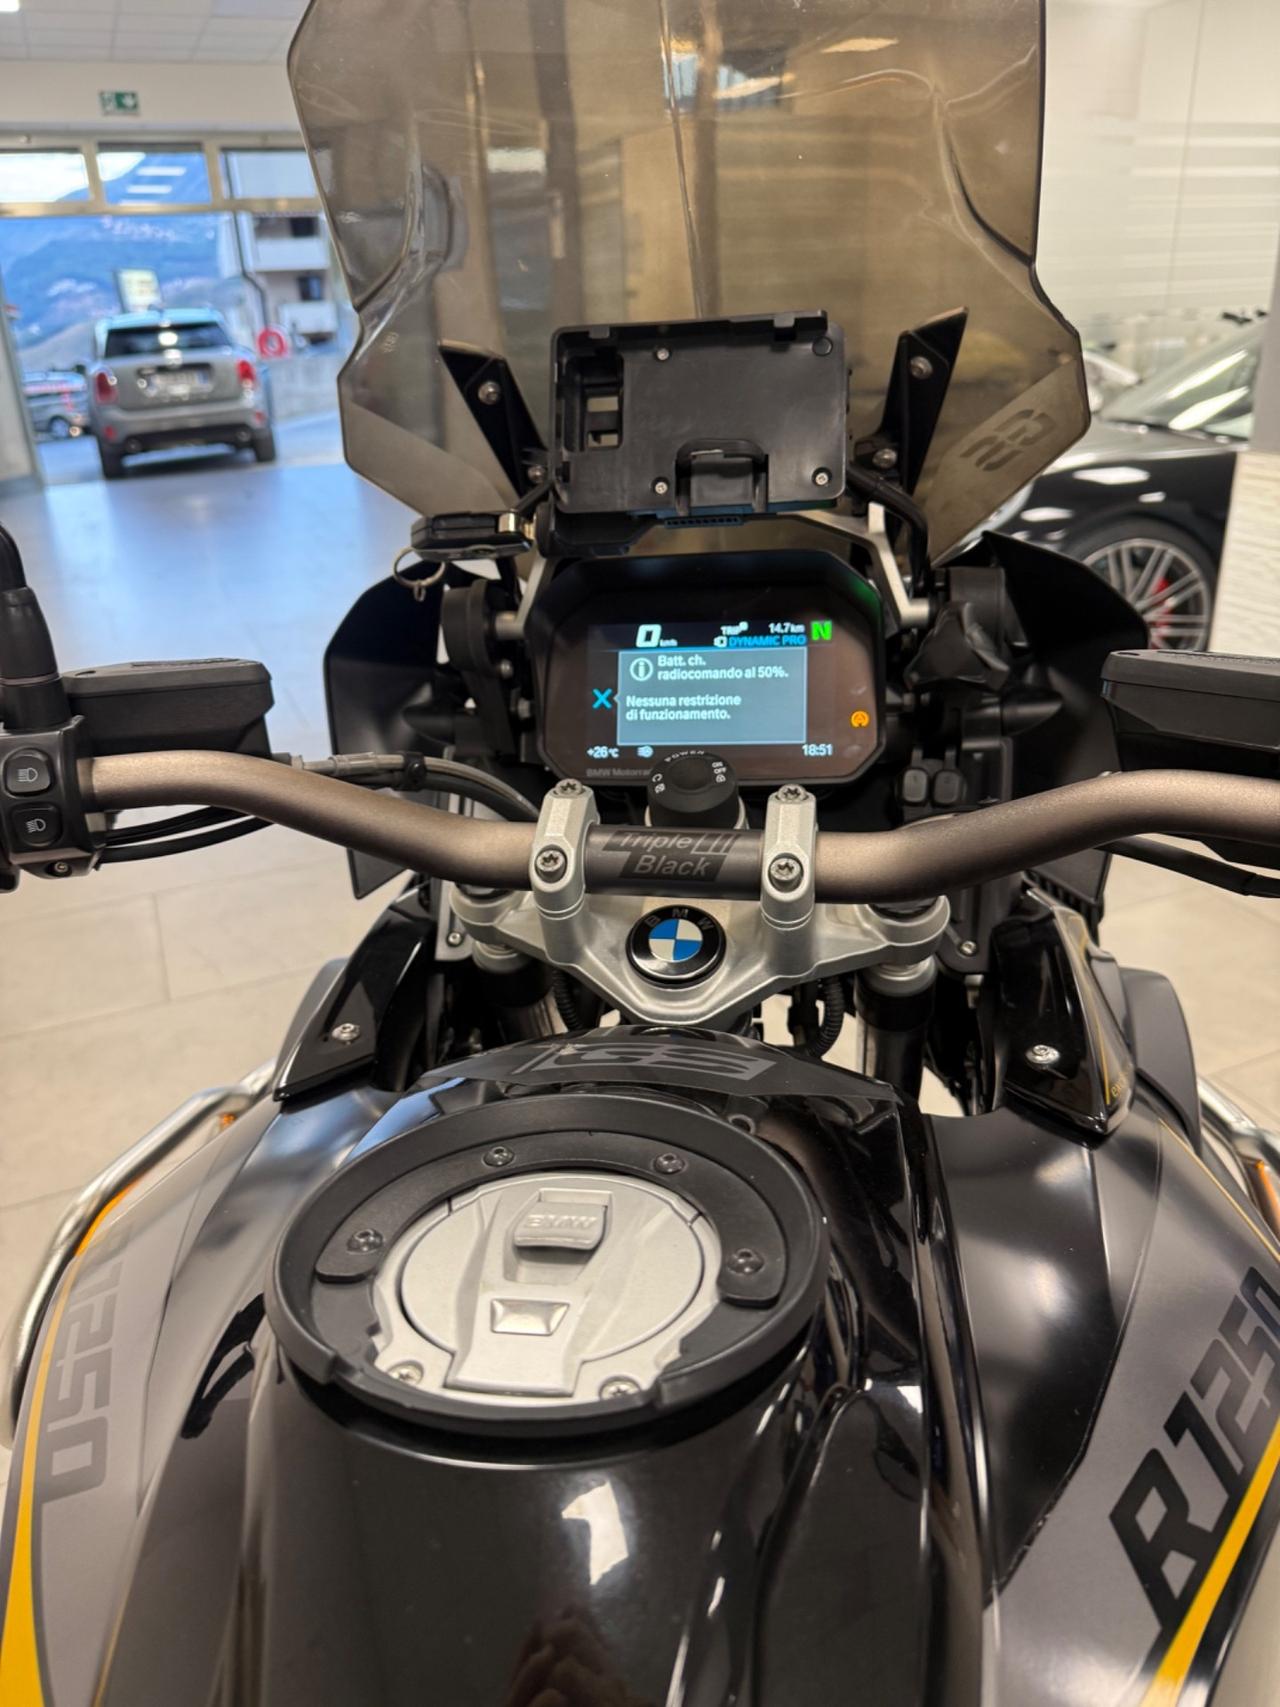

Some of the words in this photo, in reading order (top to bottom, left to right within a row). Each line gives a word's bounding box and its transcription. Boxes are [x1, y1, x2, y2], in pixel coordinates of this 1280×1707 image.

[769, 622, 791, 633] 14.7
[811, 620, 832, 640] N
[636, 624, 662, 648] 0
[729, 636, 780, 646] DYNAMIC
[782, 634, 807, 644] PRO
[657, 655, 686, 667] Batt.
[688, 654, 706, 666] ch.
[657, 668, 742, 680] radiocomando
[744, 667, 756, 678] al
[757, 665, 789, 678] 50%.
[626, 695, 676, 707] Nessuna
[678, 693, 741, 706] restrizione
[625, 709, 638, 720] di
[639, 708, 731, 720] funzionamento.
[802, 743, 832, 756] 18:51
[586, 768, 610, 777] BMW
[612, 768, 651, 776] Motorra
[619, 833, 693, 852] Triple
[634, 855, 712, 876] Black
[645, 908, 714, 931] BMW
[527, 1214, 597, 1228] BMW
